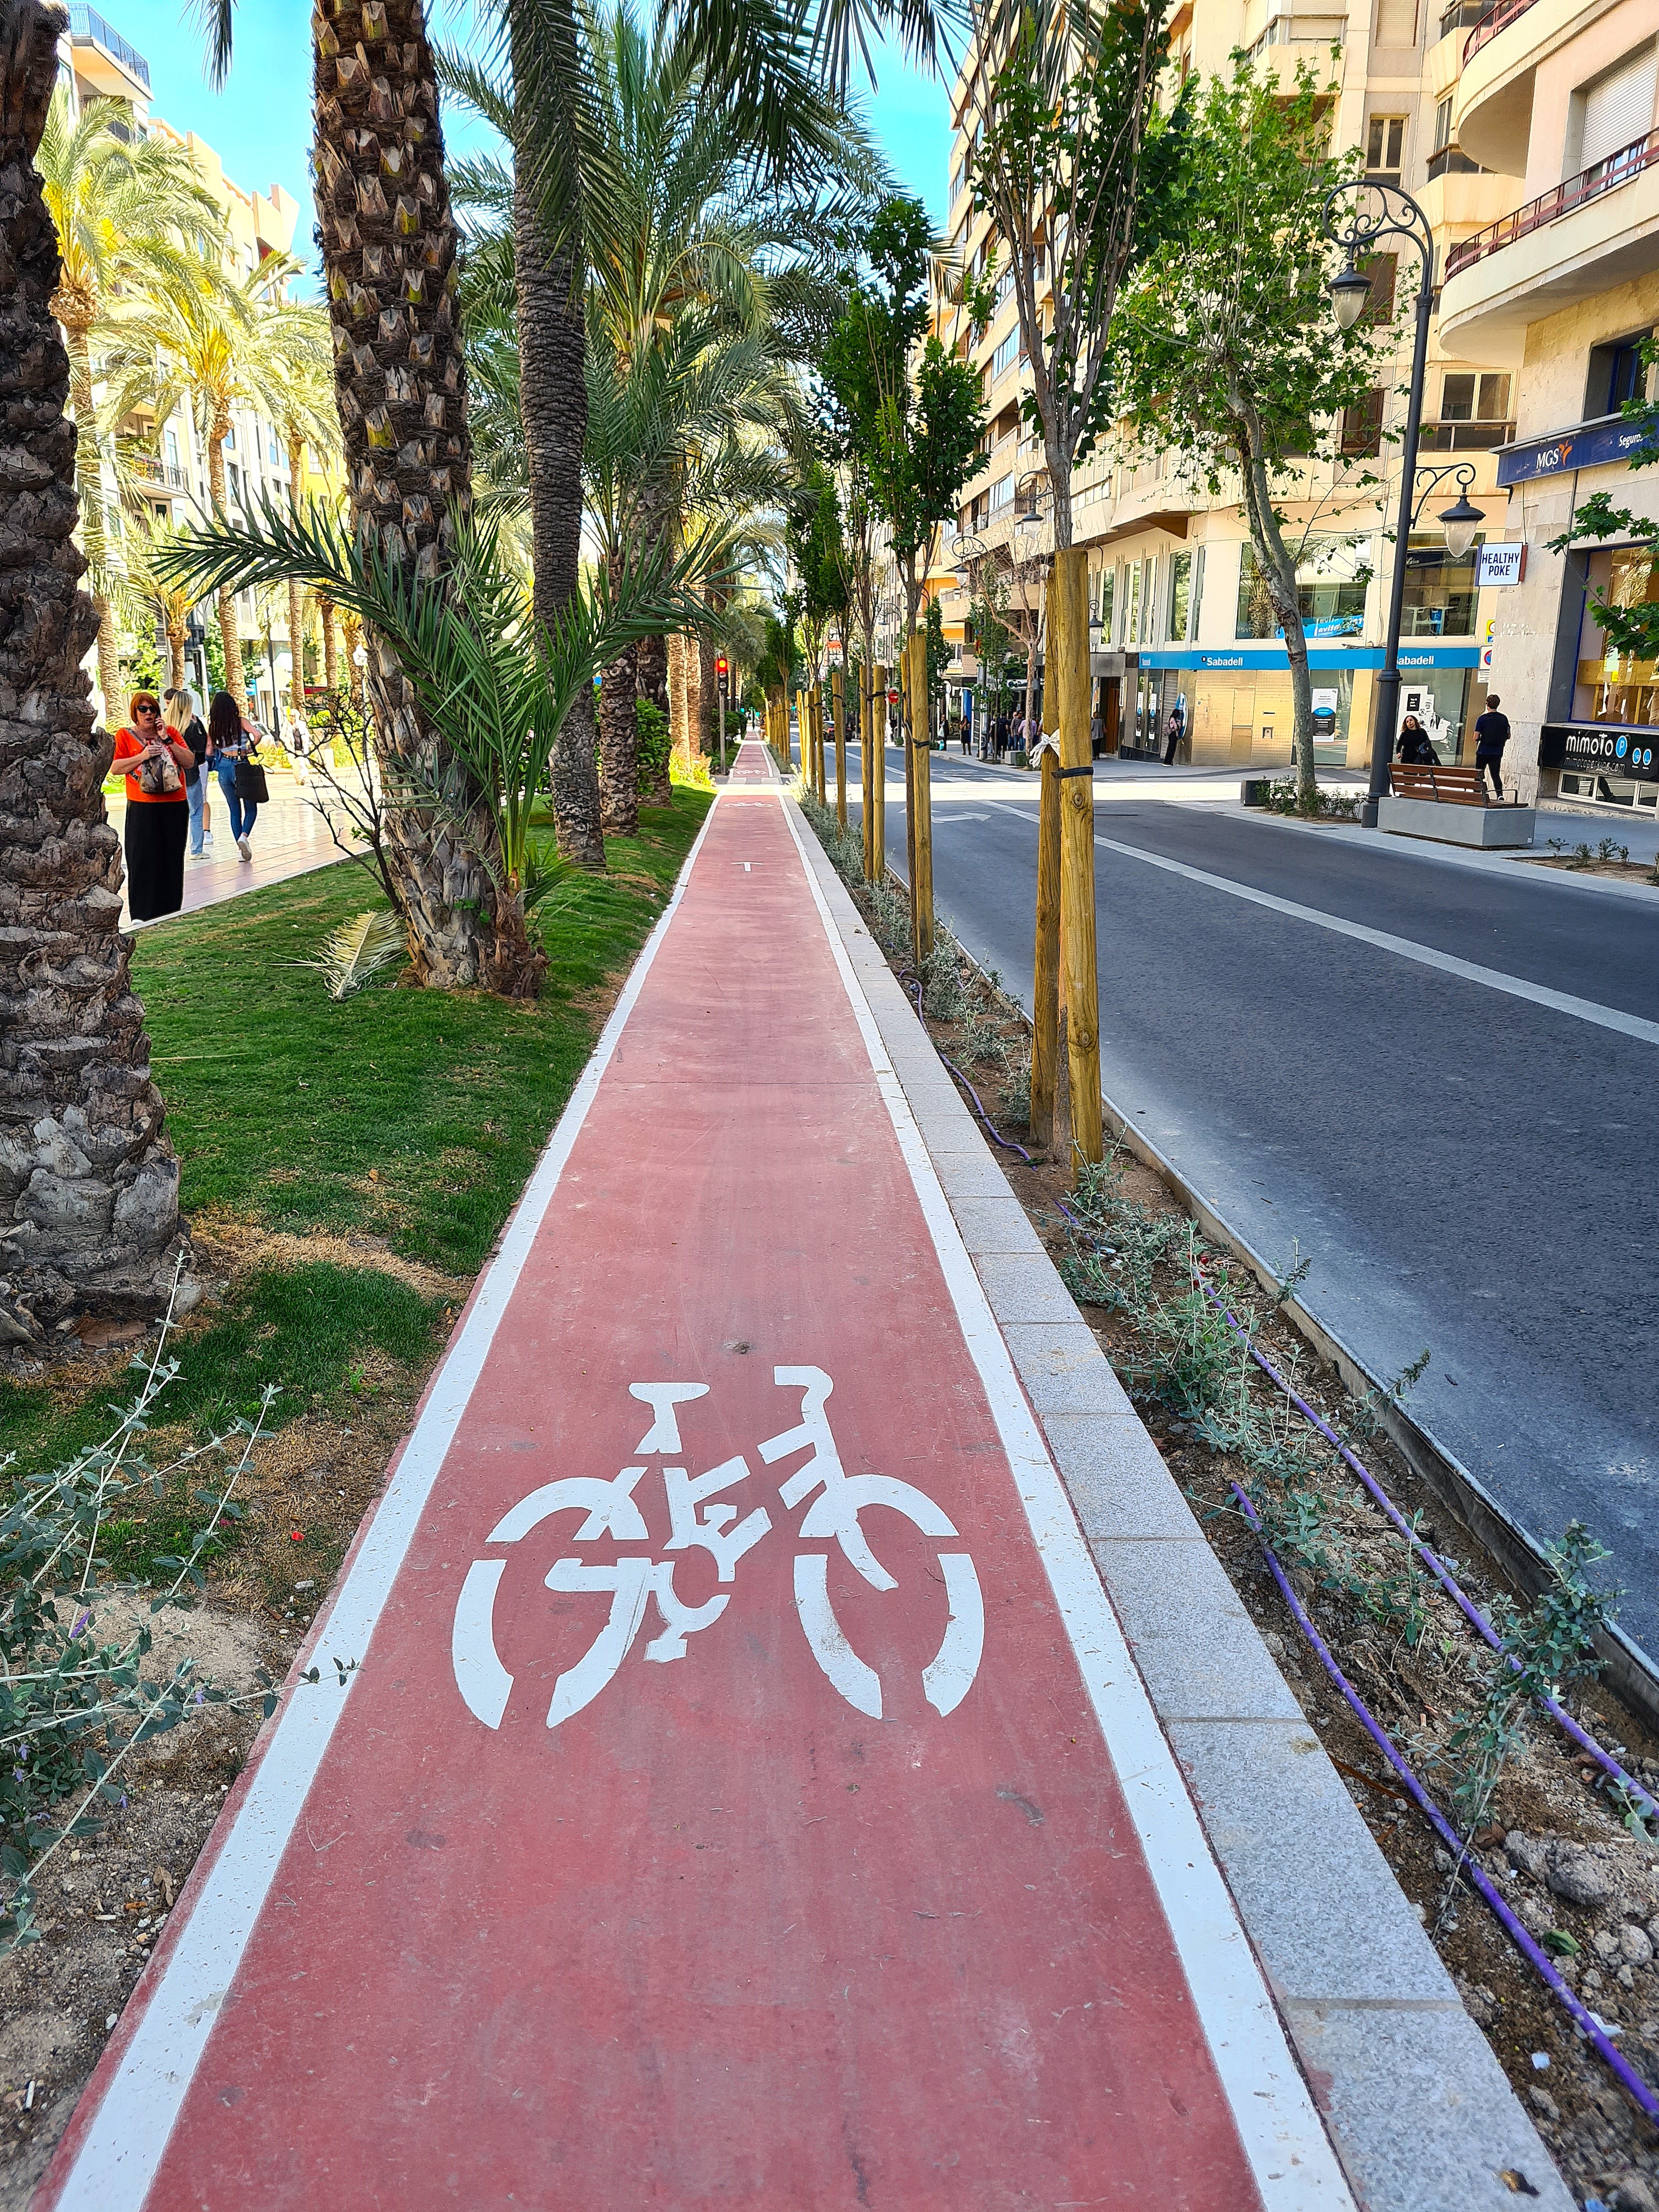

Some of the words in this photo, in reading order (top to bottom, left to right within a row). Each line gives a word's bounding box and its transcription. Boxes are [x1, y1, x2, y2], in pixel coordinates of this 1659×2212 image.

[1536, 448, 1559, 469] MGS
[1619, 434, 1643, 448] Seguro
[1482, 552, 1520, 564] HEALTHY
[1488, 565, 1510, 576] POKE
[1207, 657, 1243, 666] Sabadell
[1397, 655, 1434, 665] abadell
